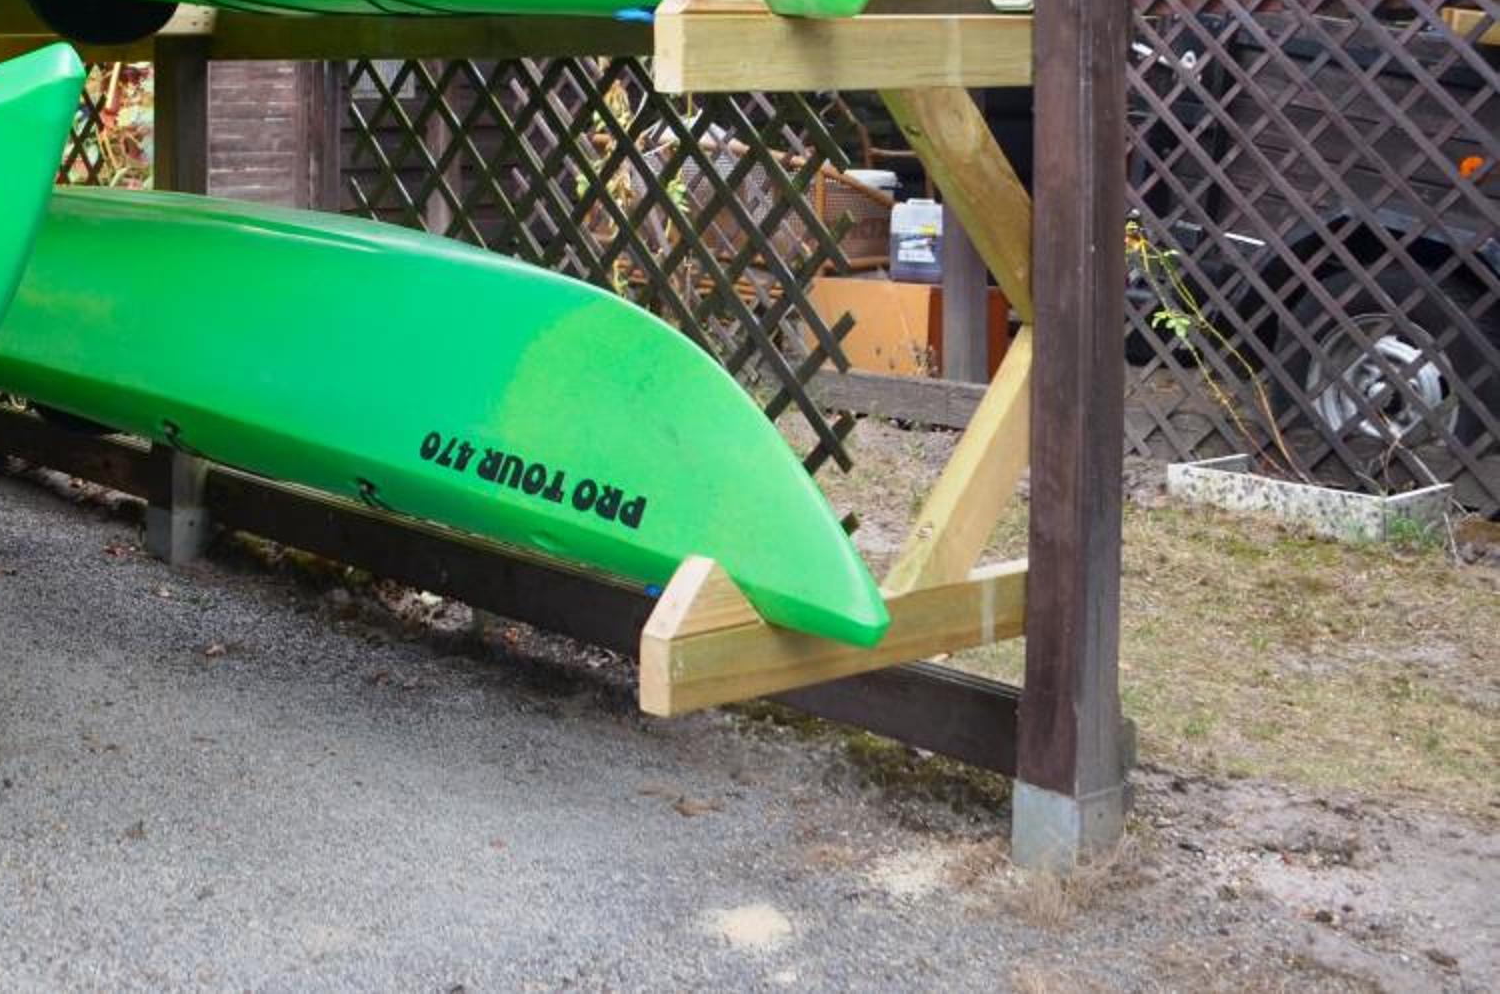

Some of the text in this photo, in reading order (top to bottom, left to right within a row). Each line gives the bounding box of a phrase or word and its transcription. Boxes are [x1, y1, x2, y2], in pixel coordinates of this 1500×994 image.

[419, 431, 647, 529] PRO TOUR 470
